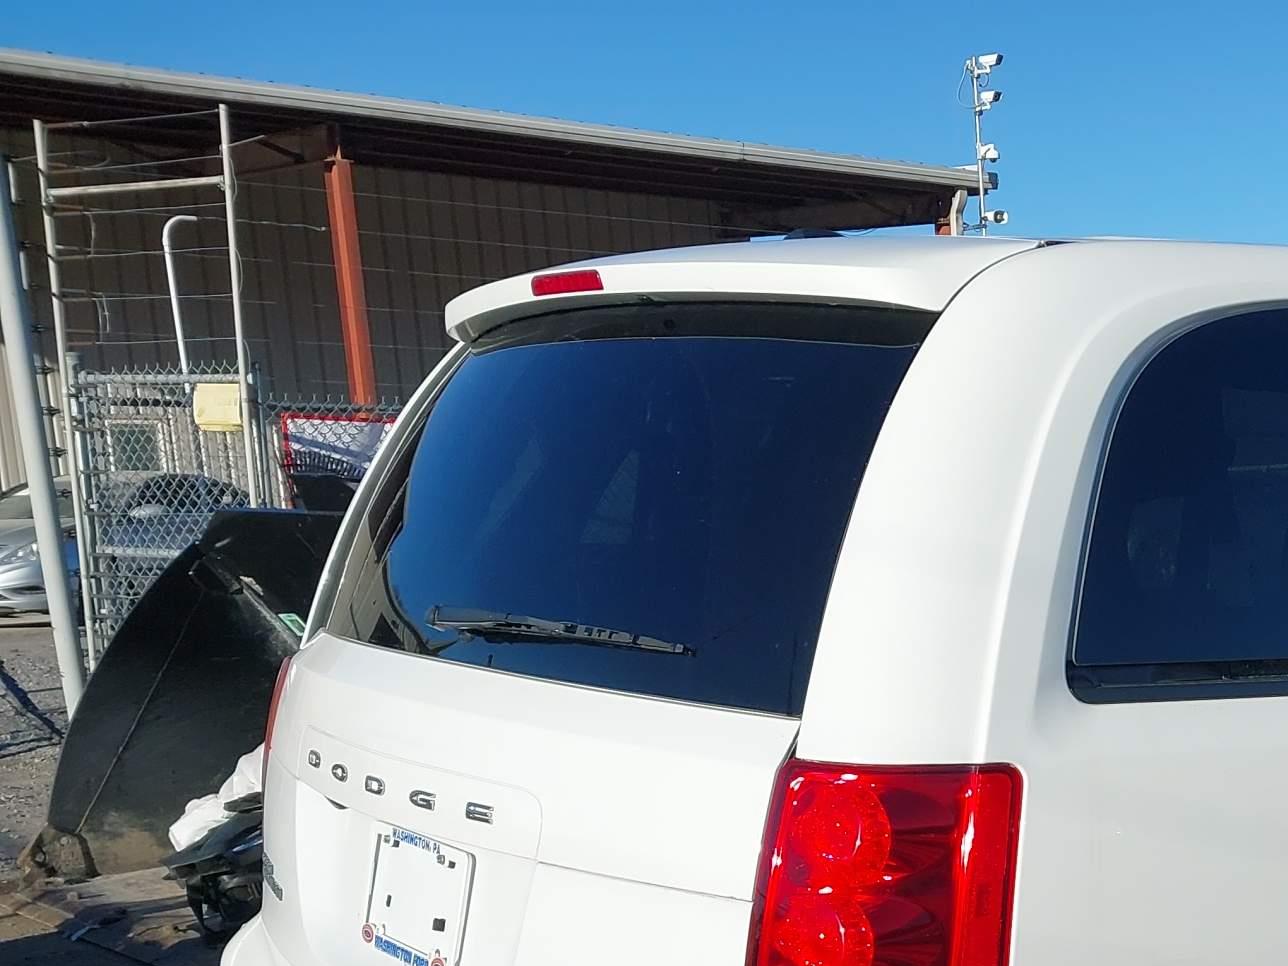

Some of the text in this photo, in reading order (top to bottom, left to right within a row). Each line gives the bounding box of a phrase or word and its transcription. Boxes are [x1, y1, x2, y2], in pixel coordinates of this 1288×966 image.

[307, 749, 495, 825] DODGE
[432, 842, 441, 855] PA
[374, 935, 412, 965] WASHINGTON
